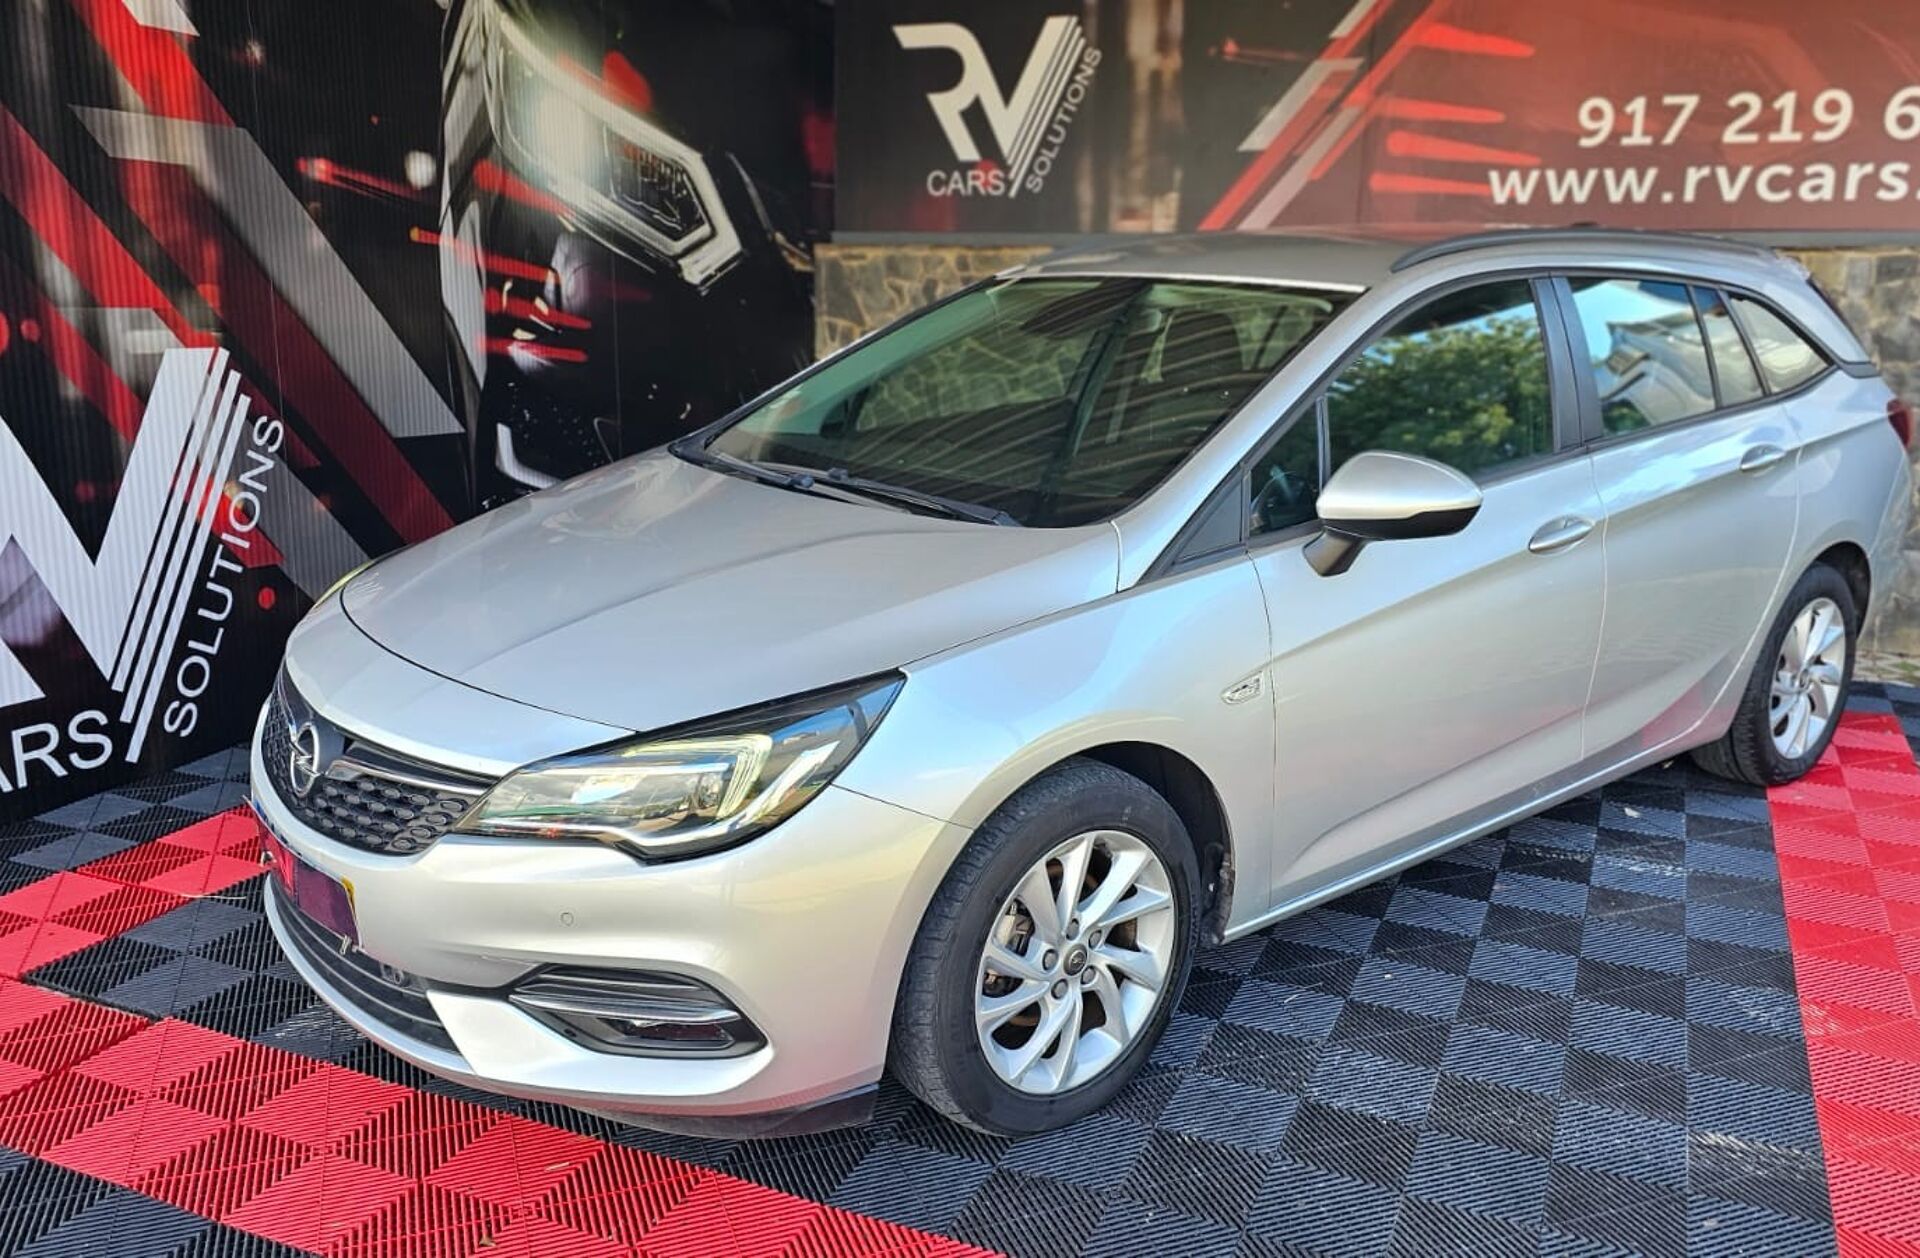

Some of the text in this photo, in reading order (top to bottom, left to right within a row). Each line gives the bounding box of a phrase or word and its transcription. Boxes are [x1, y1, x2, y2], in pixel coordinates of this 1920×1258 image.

[892, 16, 1080, 166] RV
[1025, 48, 1102, 193] SOLUTIONS
[1578, 86, 1920, 148] 917 219 6
[927, 170, 1006, 196] CARS
[164, 415, 284, 737] SOLUTIONS
